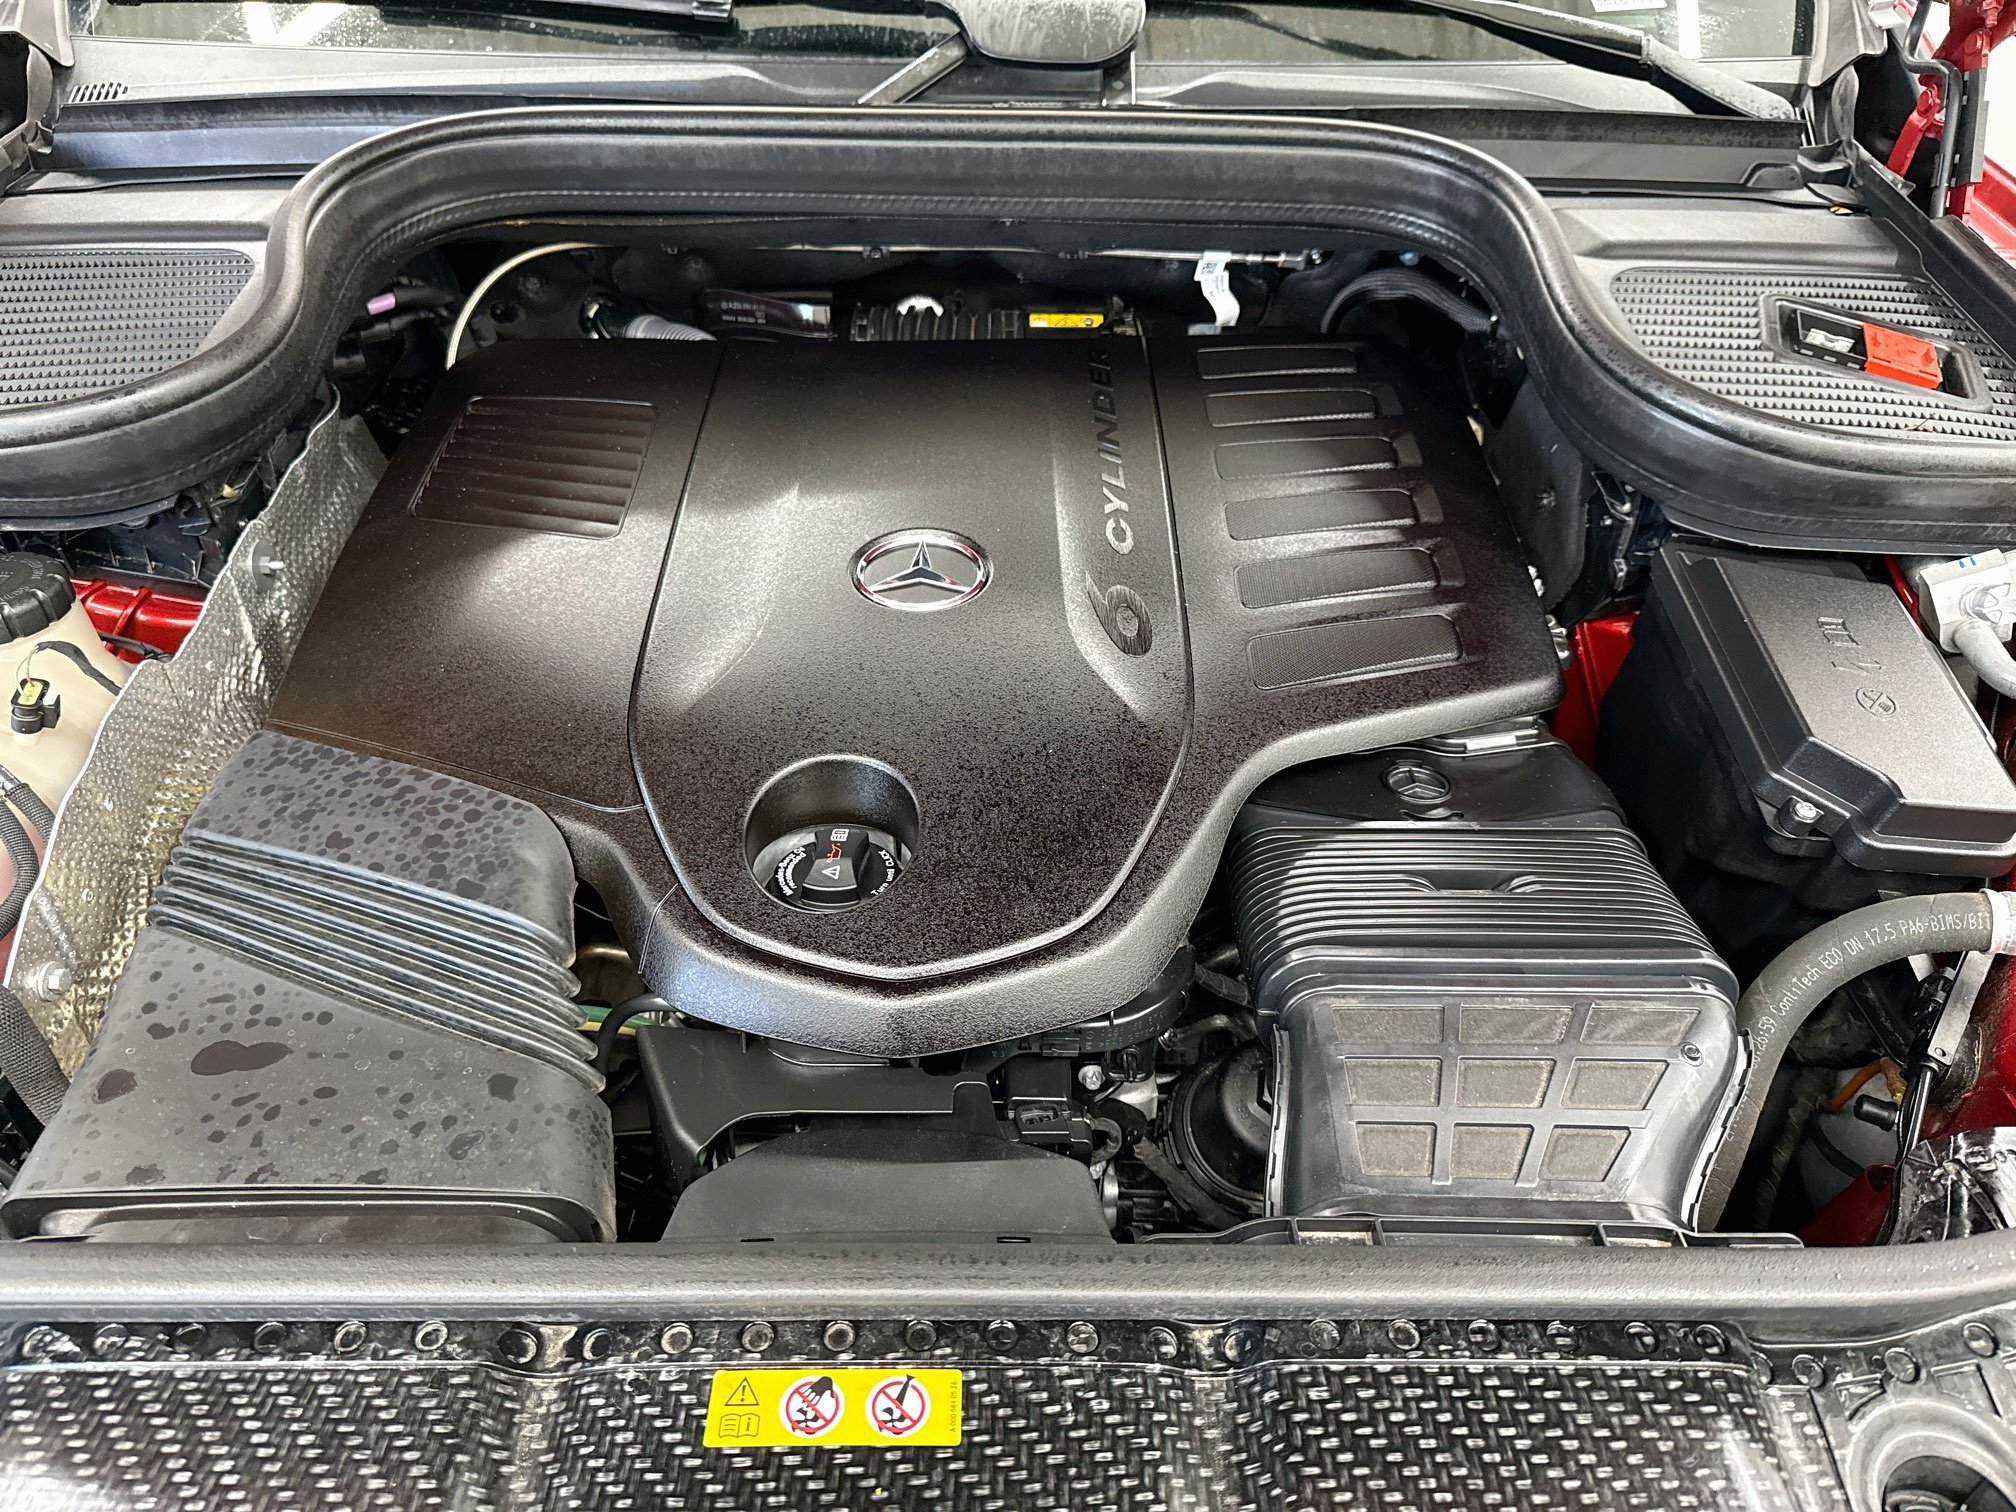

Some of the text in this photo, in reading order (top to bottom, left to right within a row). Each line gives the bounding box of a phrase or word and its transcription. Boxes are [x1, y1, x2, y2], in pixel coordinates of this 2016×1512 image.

[1085, 349, 1153, 658] 6 CYLINDER
[870, 882, 890, 896] Turn
[885, 868, 896, 882] until
[1769, 964, 1823, 1017] ContiTech
[1817, 947, 1845, 970] ECO
[1843, 936, 1865, 956] DN
